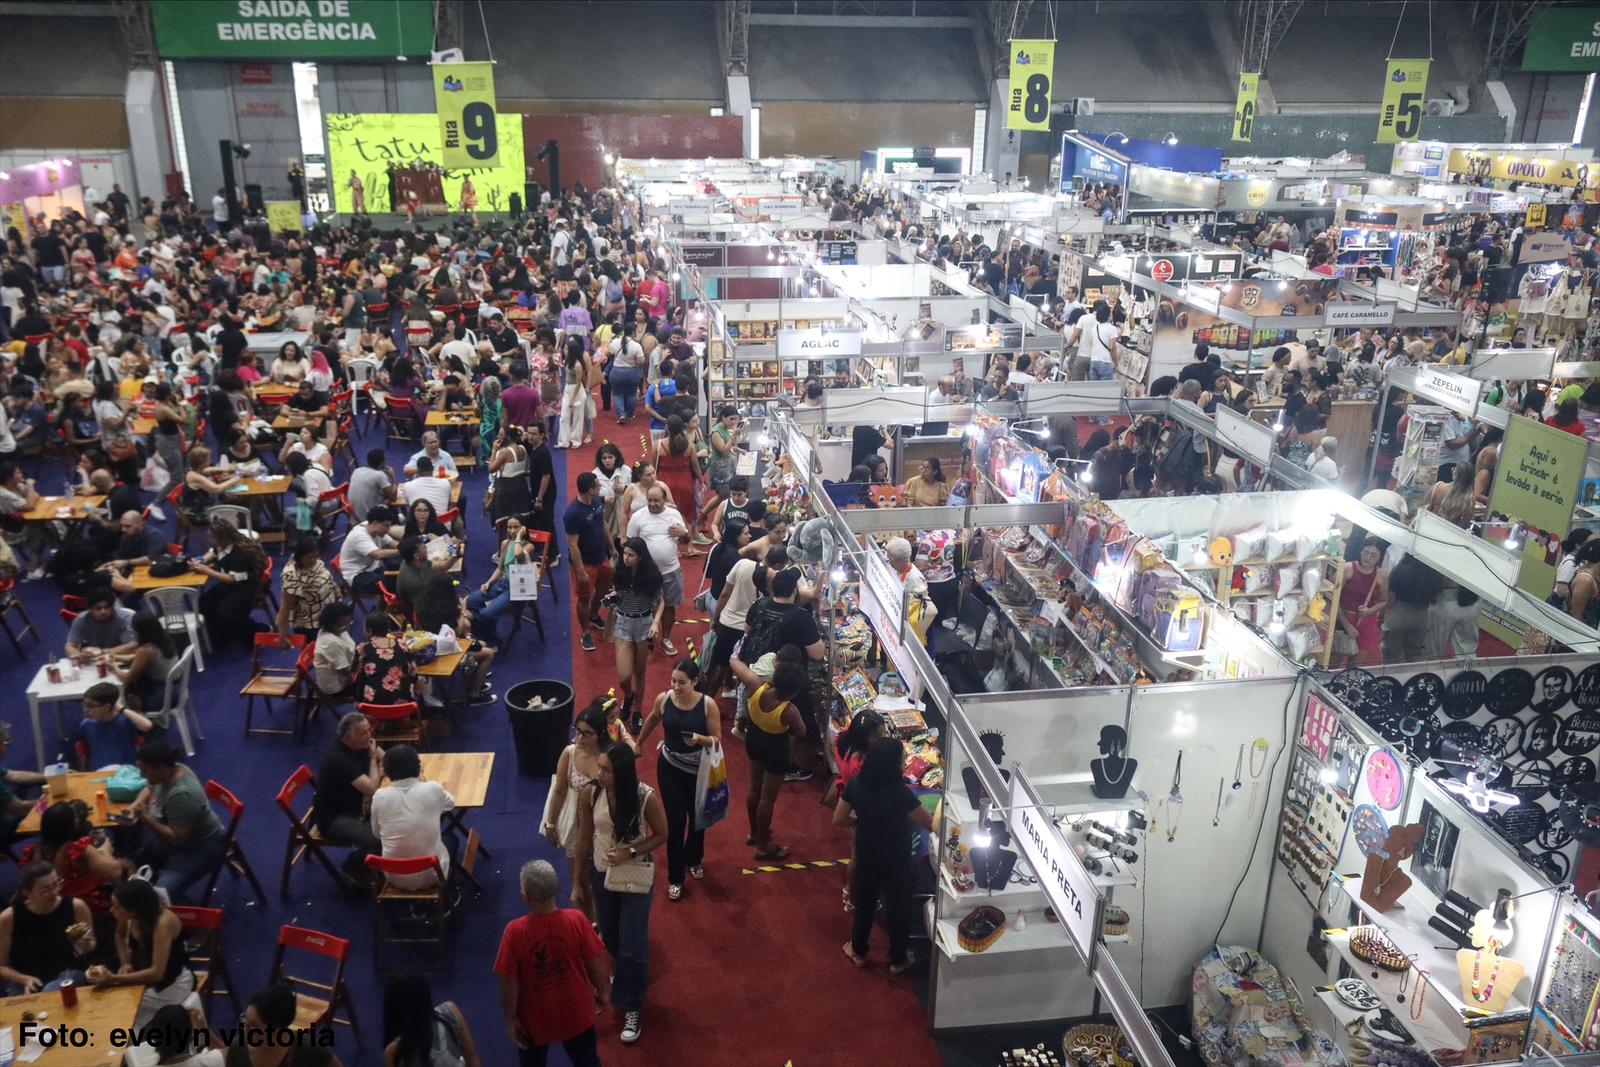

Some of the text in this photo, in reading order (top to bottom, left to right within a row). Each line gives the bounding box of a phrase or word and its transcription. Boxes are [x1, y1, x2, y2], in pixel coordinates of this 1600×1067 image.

[318, 0, 350, 17] DE
[217, 19, 376, 41] EMERGÊNCIA
[1010, 73, 1050, 123] Rua 8
[1382, 92, 1422, 139] Rua 5
[445, 101, 498, 160] Rua 9
[1432, 376, 1463, 395] ZEPELIN
[1529, 445, 1557, 465] Aqui o
[1505, 470, 1531, 491] levado
[1533, 484, 1538, 494] a
[1519, 458, 1558, 484] brincar é
[1022, 809, 1082, 921] MARIA PRETA
